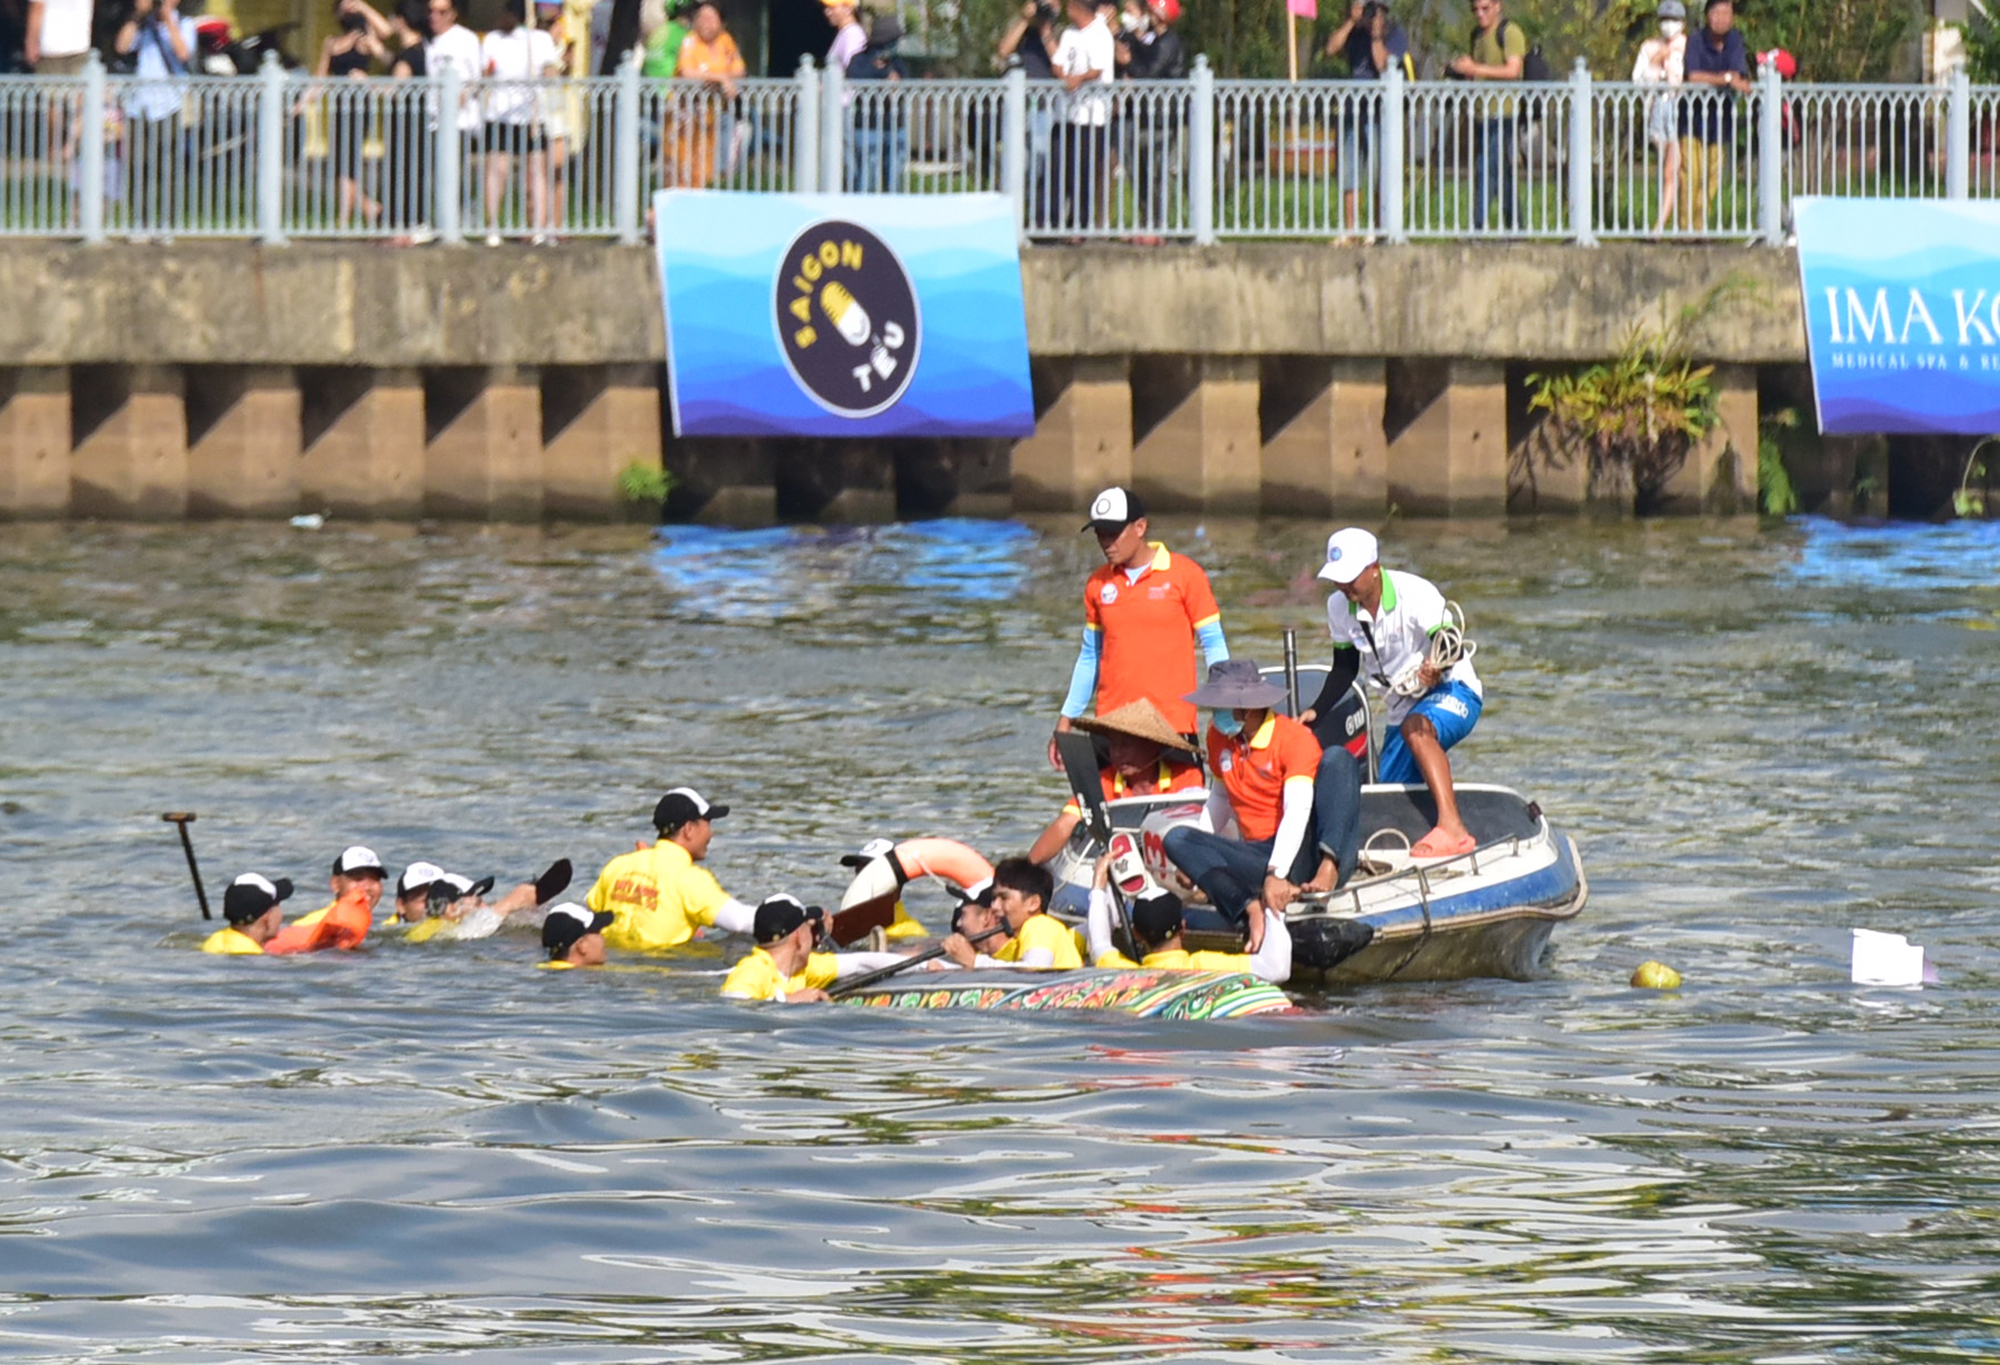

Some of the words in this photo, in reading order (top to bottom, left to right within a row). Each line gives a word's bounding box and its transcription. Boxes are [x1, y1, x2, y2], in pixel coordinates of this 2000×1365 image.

[1825, 287, 1943, 345] IMA
[1952, 288, 2000, 346] K
[1832, 352, 1909, 369] MEDICAL
